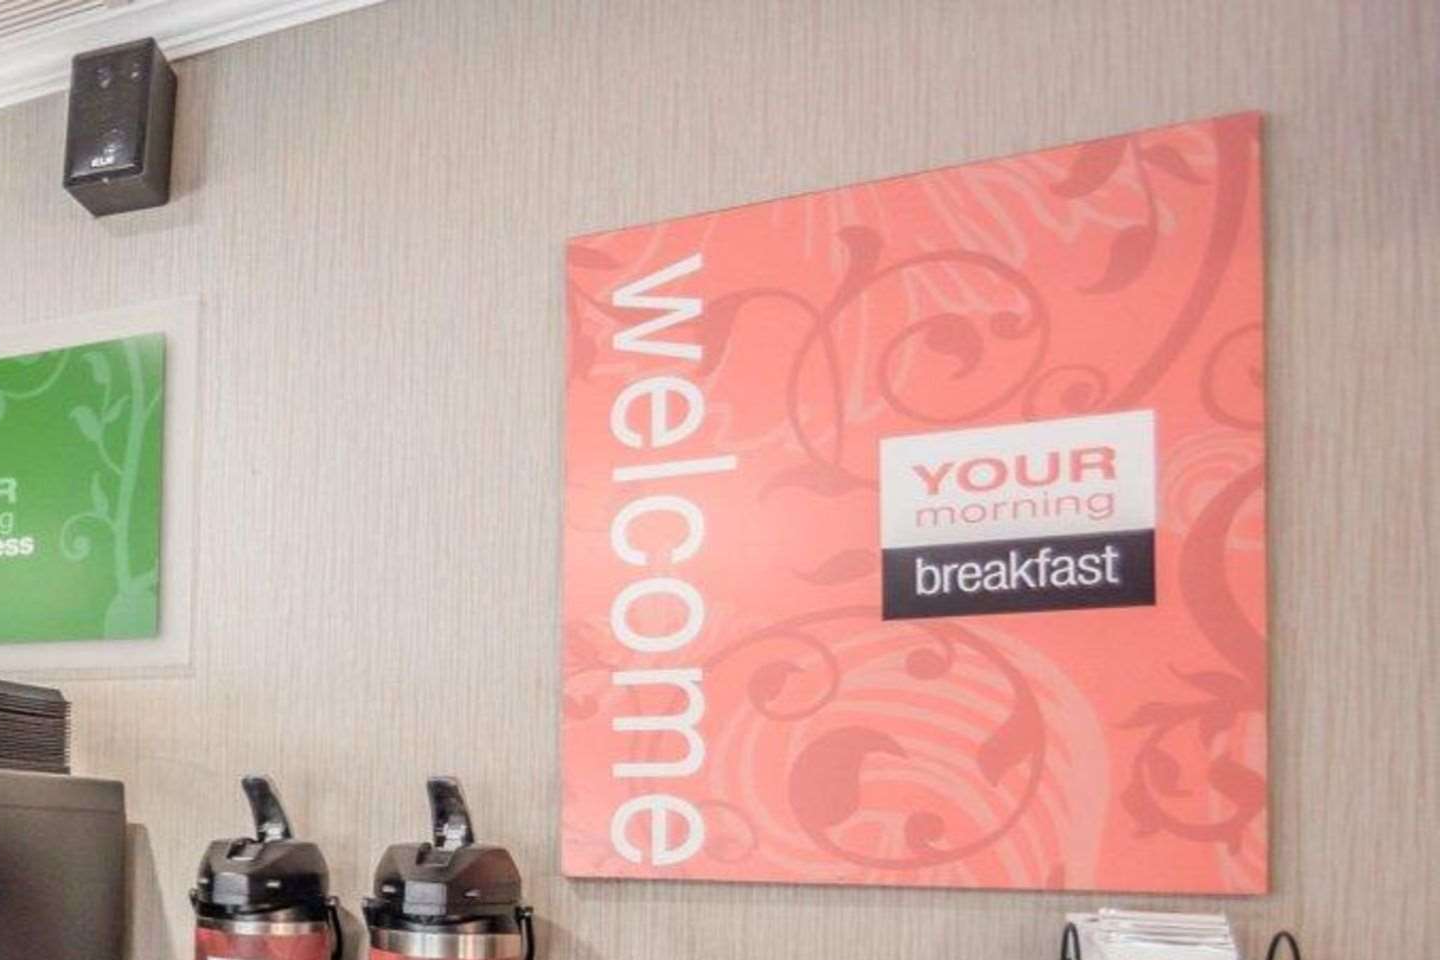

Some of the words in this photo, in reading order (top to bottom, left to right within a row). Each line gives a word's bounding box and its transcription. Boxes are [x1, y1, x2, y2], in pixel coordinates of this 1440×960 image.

[913, 447, 1117, 495] YOUR
[915, 491, 1116, 529] morning
[609, 253, 737, 867] welcome
[914, 545, 1119, 597] breakfast
